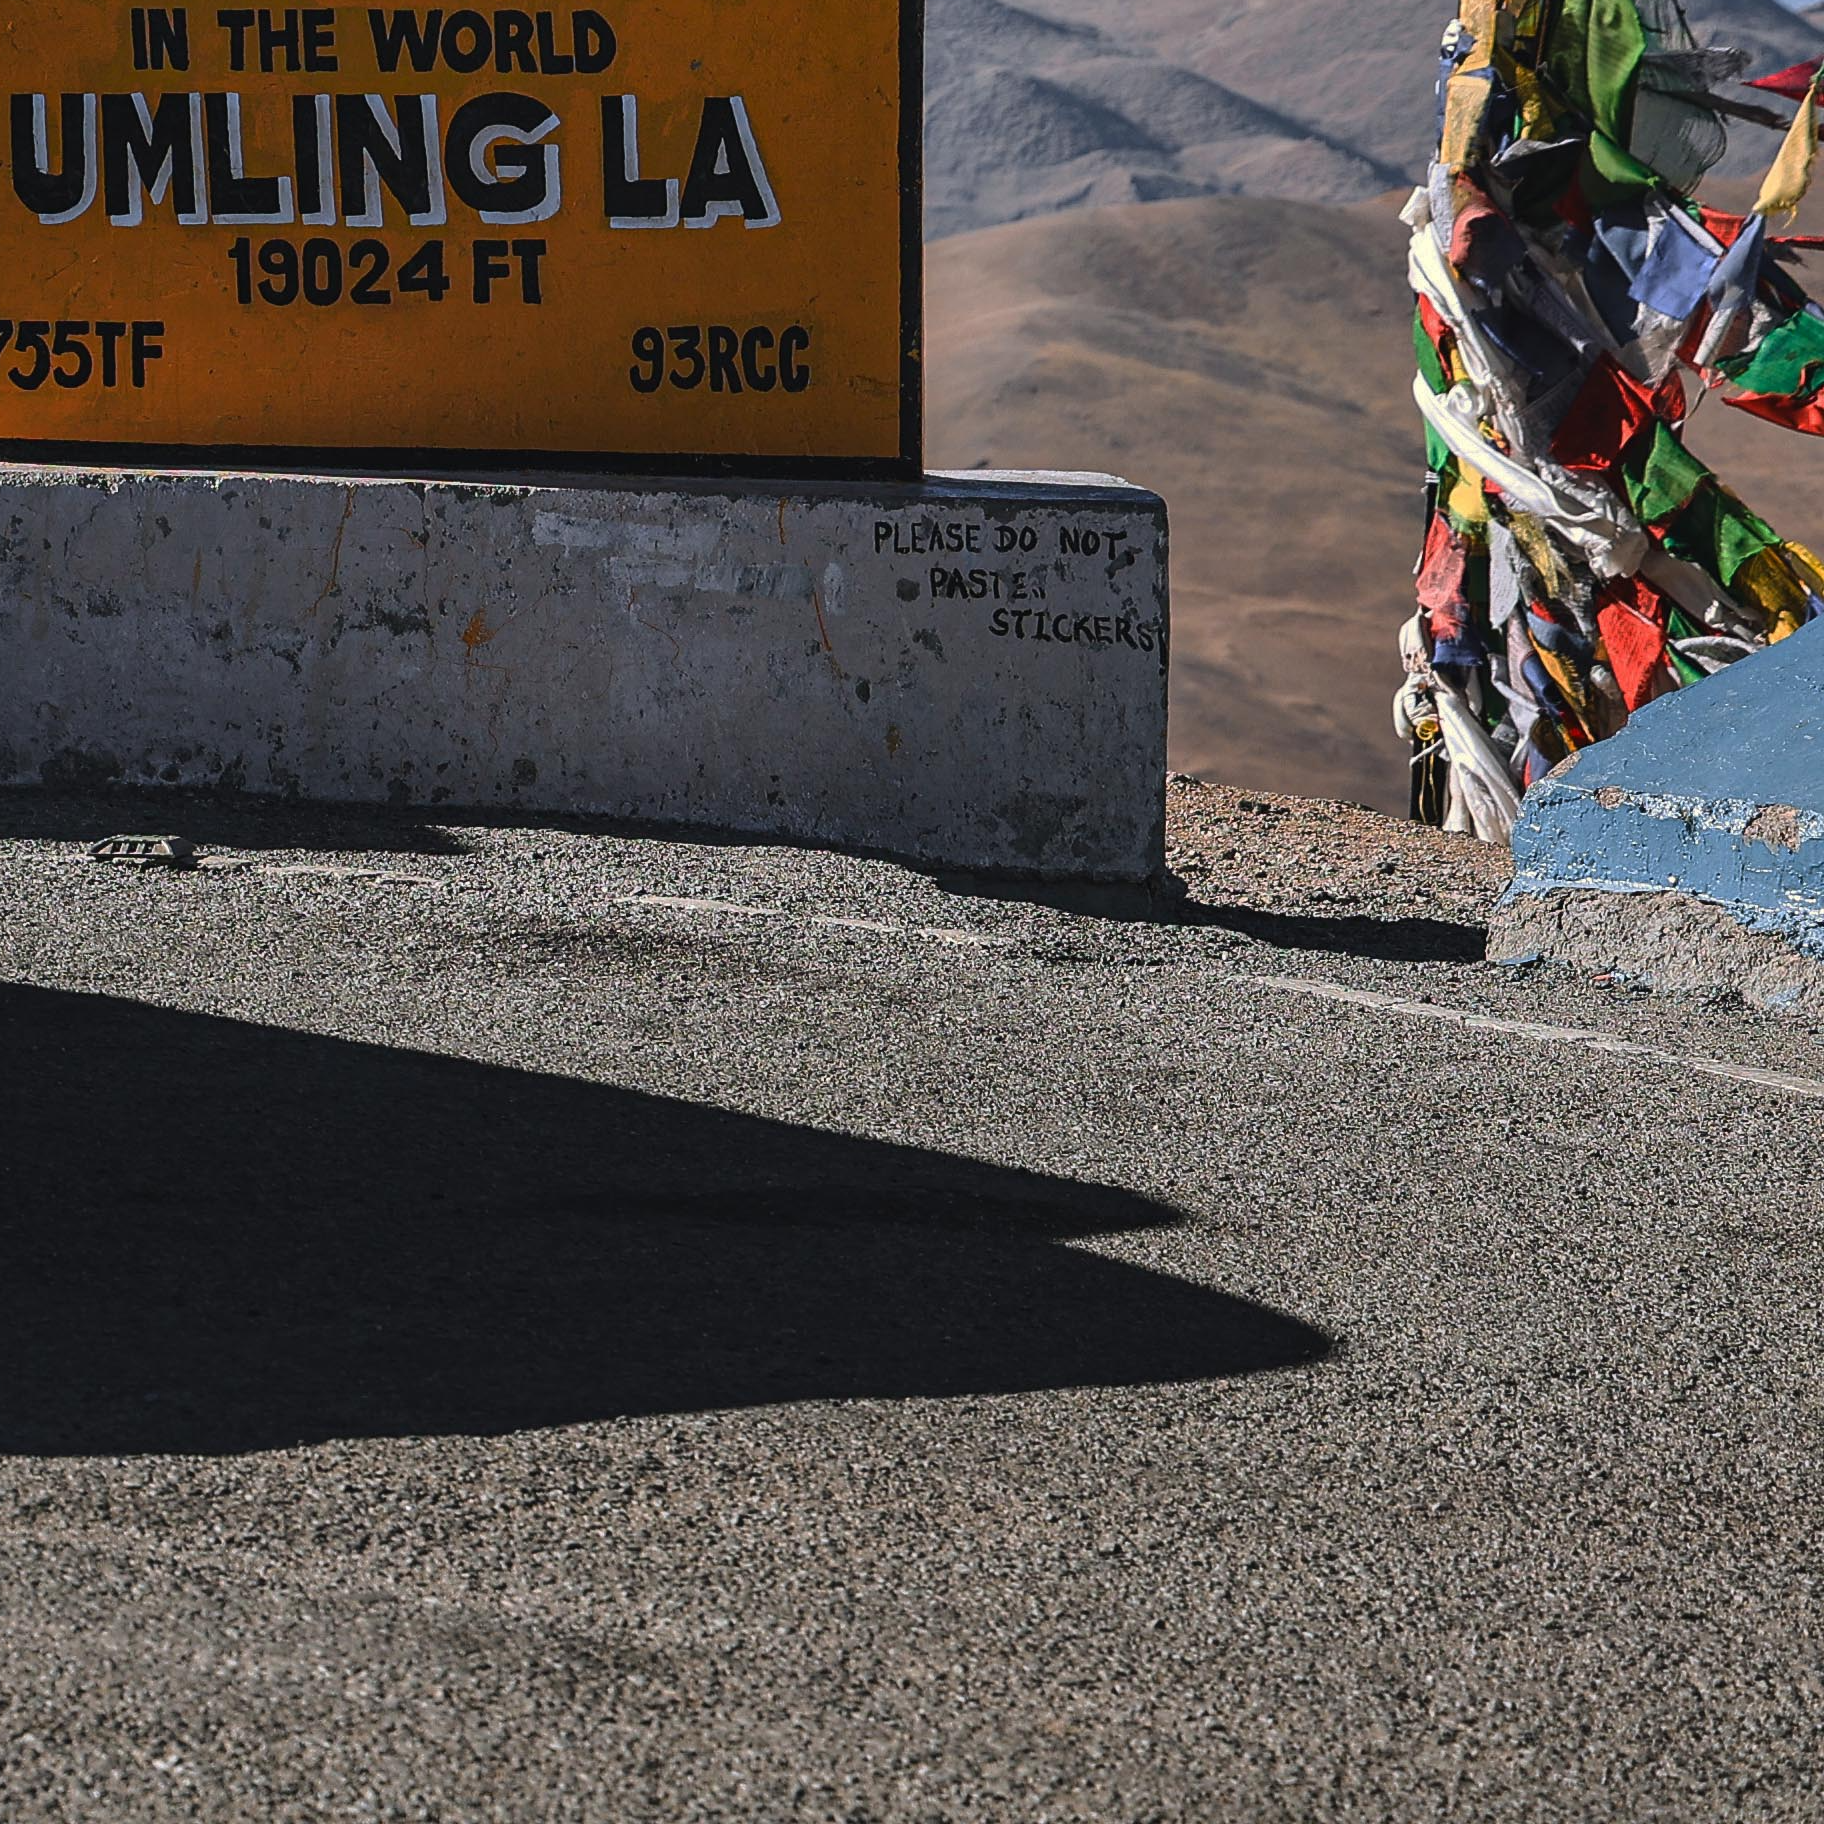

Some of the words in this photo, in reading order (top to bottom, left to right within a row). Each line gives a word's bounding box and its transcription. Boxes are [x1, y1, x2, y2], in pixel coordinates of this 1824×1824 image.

[130, 8, 190, 72] IN
[216, 8, 339, 73] THE
[368, 9, 617, 75] WORLD
[9, 90, 564, 230] UMLING
[601, 92, 782, 231] LA
[228, 237, 451, 306] 19024
[472, 239, 546, 305] FT
[629, 325, 811, 394] 93RCC
[874, 521, 981, 554] PLEASE
[993, 525, 1038, 553] DO
[1059, 526, 1128, 561] NOT
[929, 567, 1028, 600] PASTE
[987, 607, 1154, 653] STICKERS
